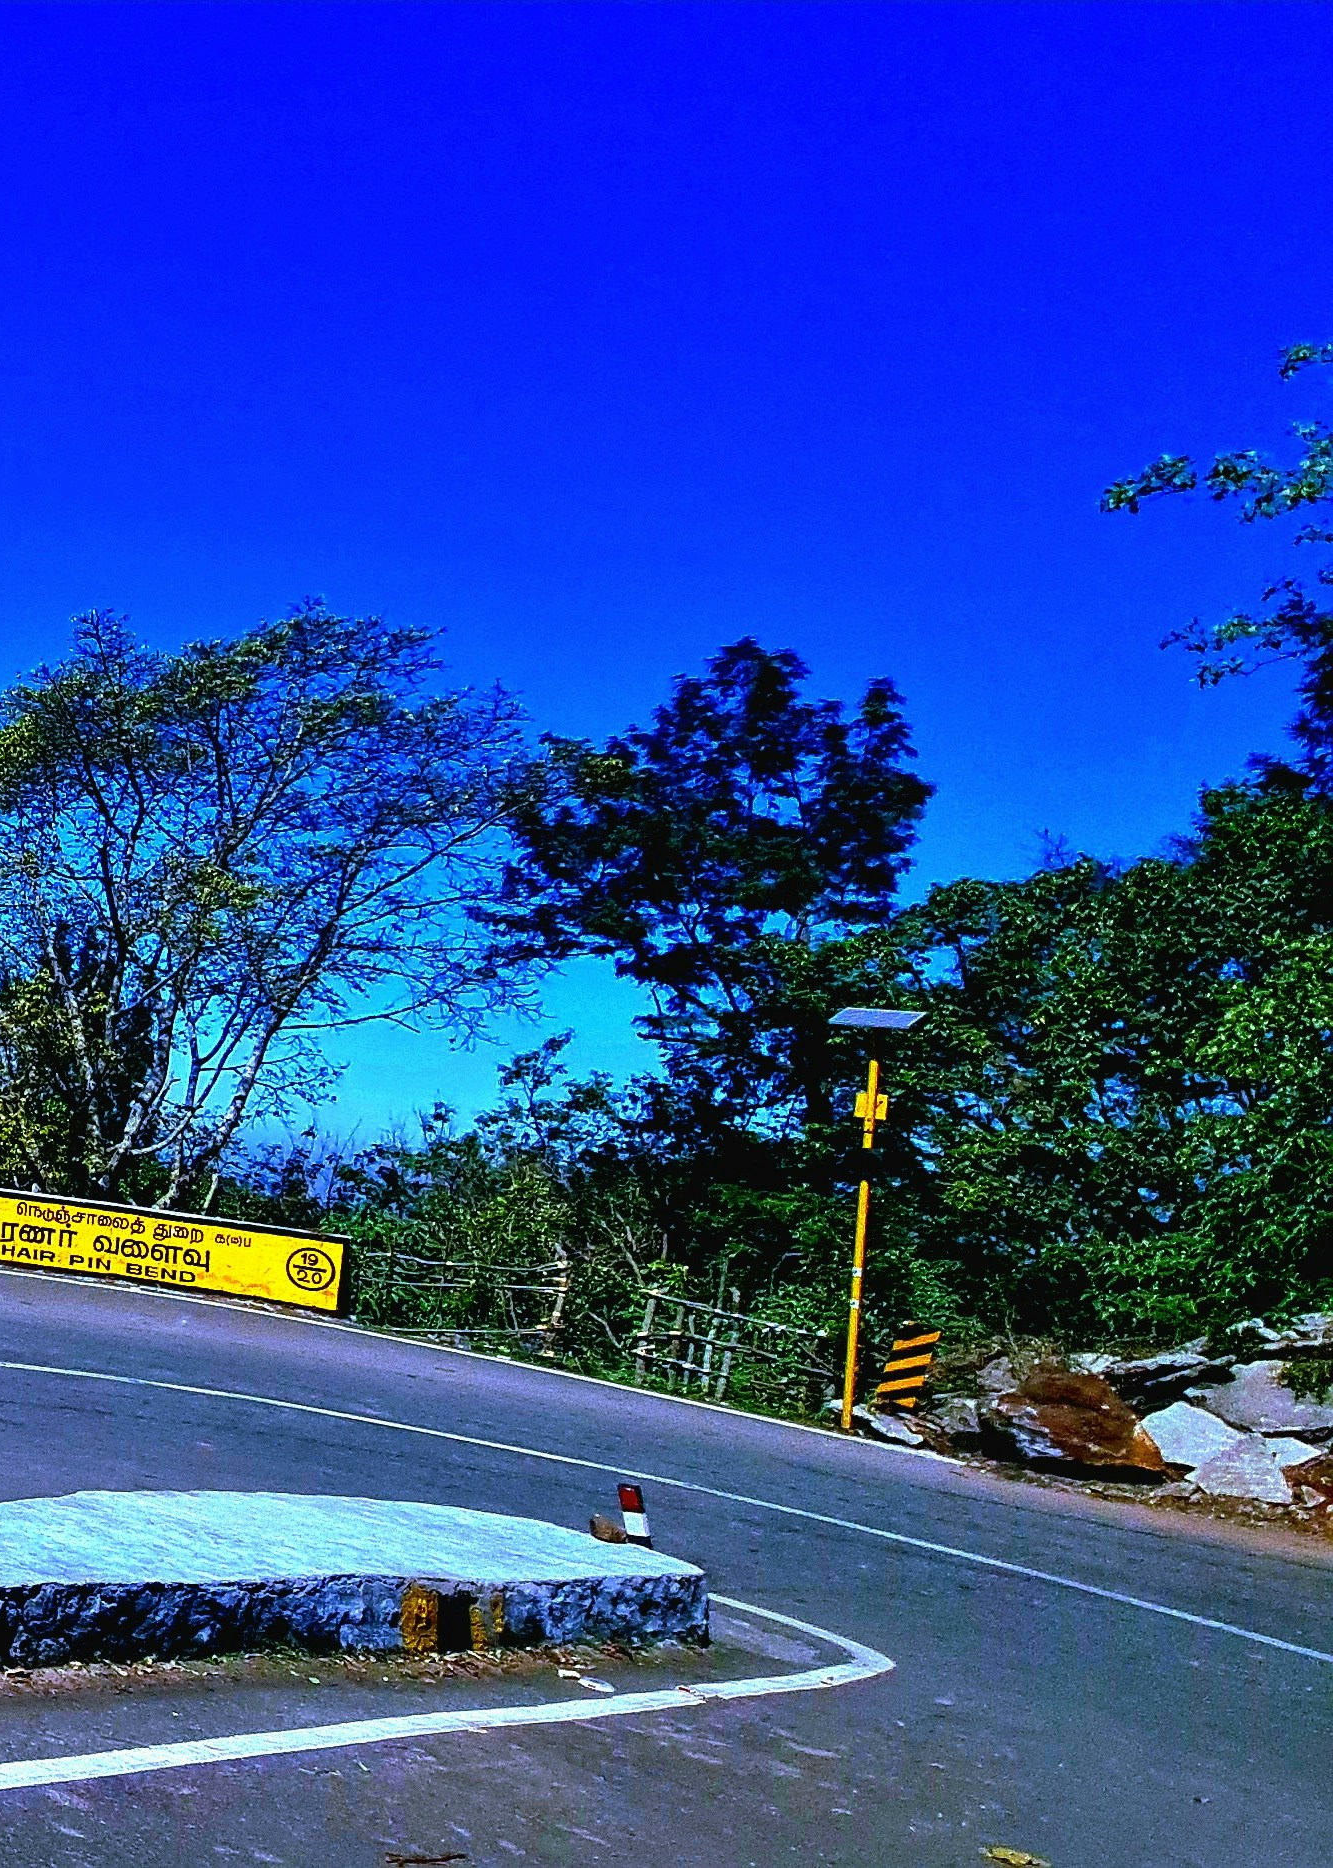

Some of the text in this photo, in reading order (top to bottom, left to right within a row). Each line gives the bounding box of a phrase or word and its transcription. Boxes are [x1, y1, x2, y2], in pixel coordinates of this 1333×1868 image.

[153, 1223, 204, 1244] துறை
[93, 1235, 211, 1272] வளைவு
[300, 1252, 319, 1266] 19
[69, 1255, 111, 1271] PIN
[126, 1263, 196, 1283] BEND
[297, 1269, 323, 1285] 20
